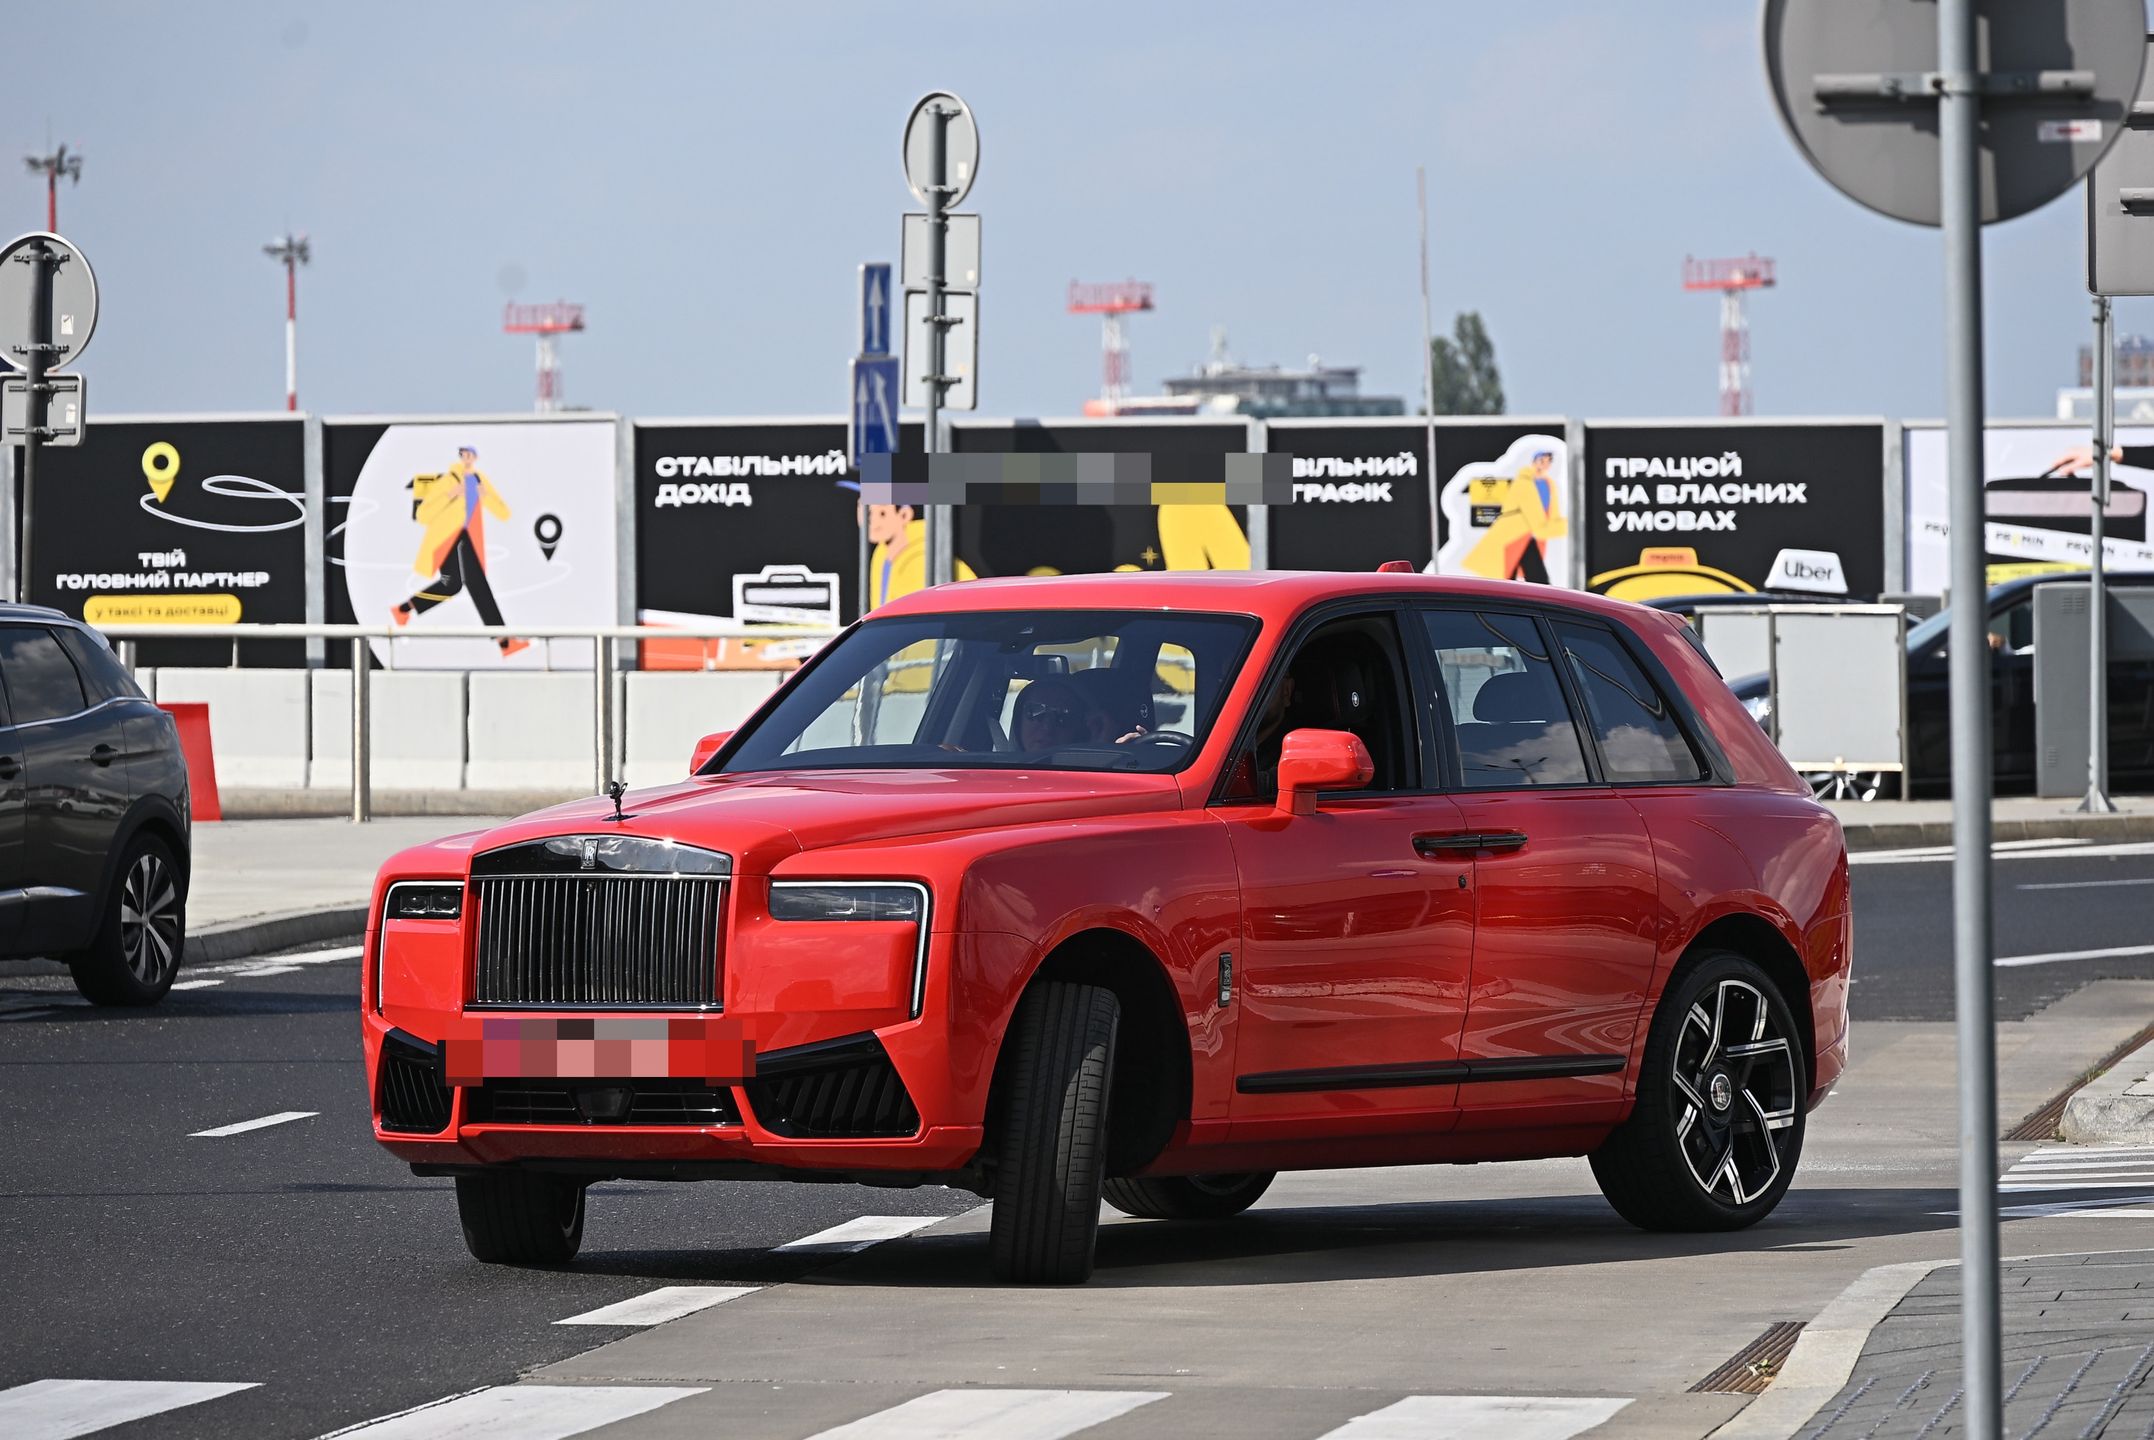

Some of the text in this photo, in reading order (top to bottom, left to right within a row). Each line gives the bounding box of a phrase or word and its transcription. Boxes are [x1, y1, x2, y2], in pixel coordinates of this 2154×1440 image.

[655, 449, 847, 477] СТАБІЛЬНИЙ
[1605, 451, 1743, 480] ПРАЦЮЙ
[655, 481, 752, 508] ДОХІД
[1606, 482, 1808, 505] НА ВЛАСНИХ
[1606, 510, 1737, 532] УМОВАХ
[138, 548, 186, 568] ТВІЙ
[56, 570, 270, 590] ГОЛОВНИЙ ПАРТНЕР
[1784, 560, 1835, 581] Uber
[109, 606, 142, 617] таксі
[148, 607, 161, 616] та
[165, 605, 228, 617] доставці
